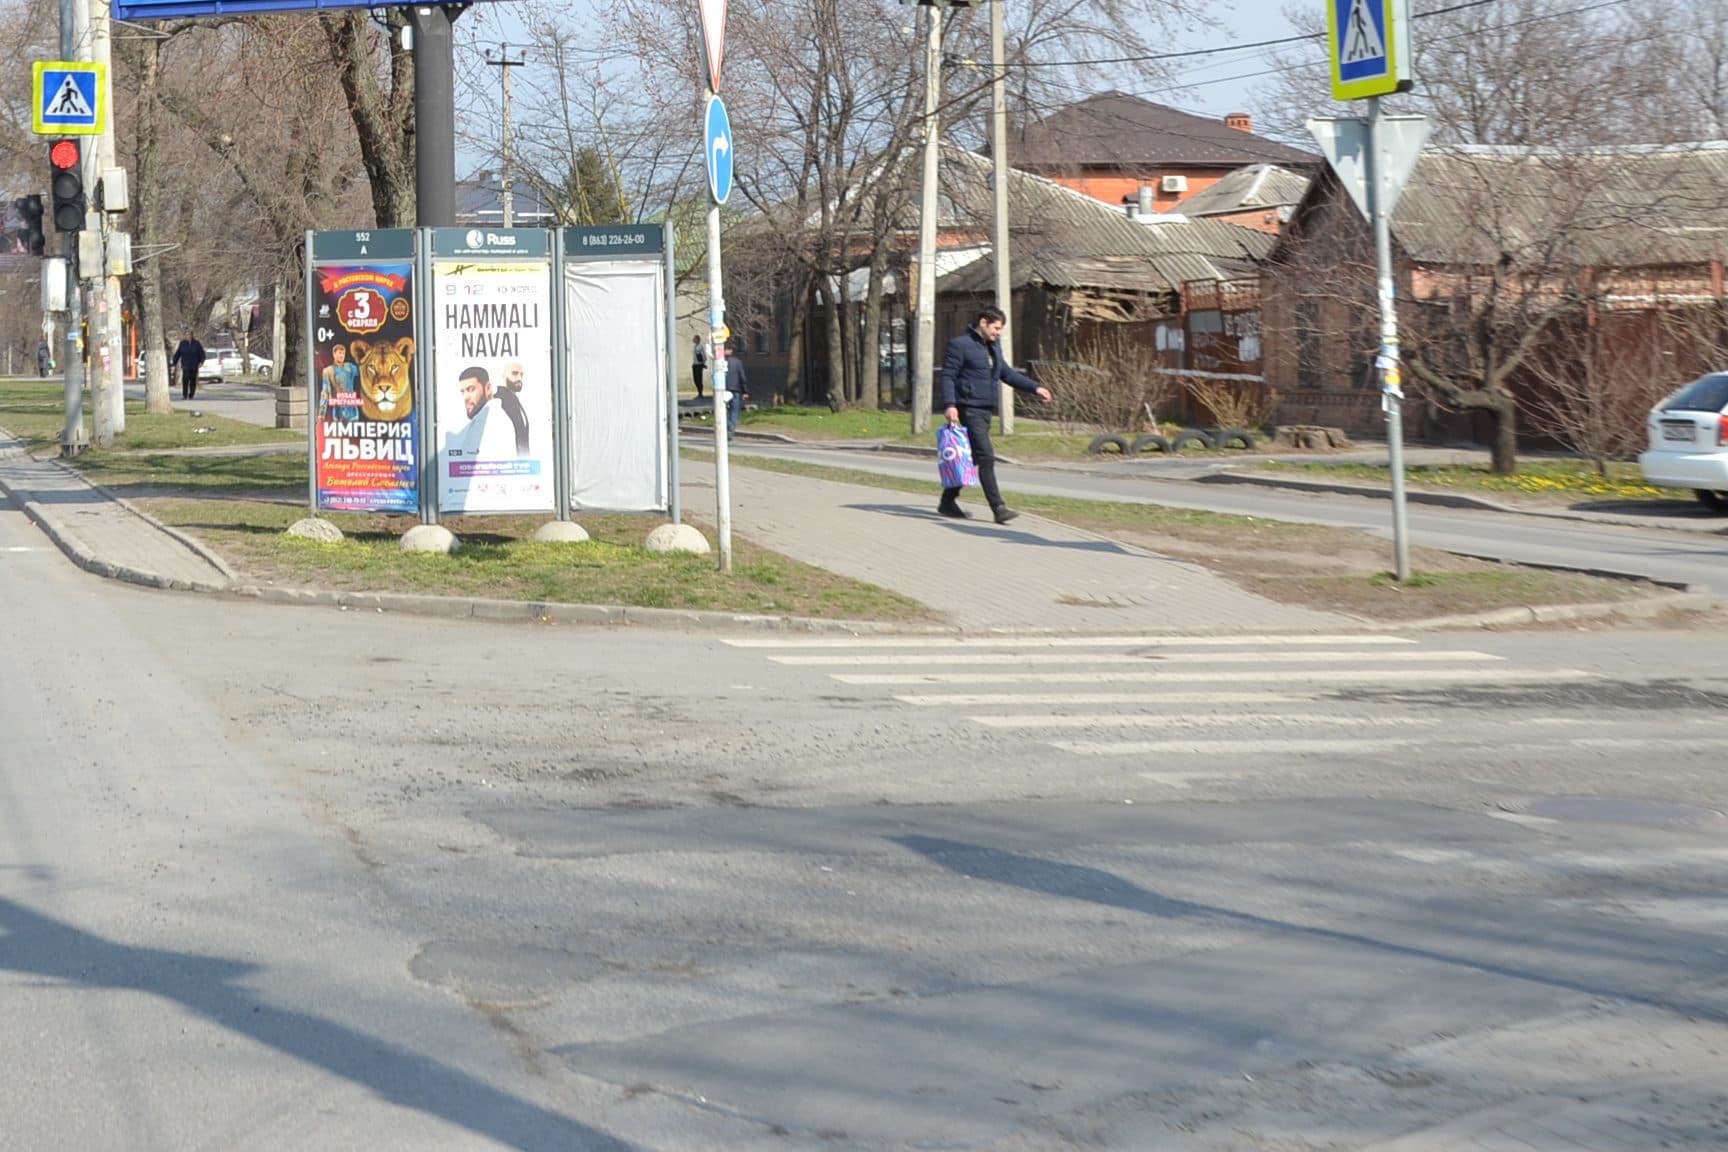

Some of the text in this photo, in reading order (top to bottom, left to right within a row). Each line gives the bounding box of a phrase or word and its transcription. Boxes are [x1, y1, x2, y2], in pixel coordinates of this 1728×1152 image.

[486, 232, 517, 246] Russ
[582, 233, 645, 246] 8 (863) 226-26-00
[354, 292, 370, 319] 3
[347, 318, 378, 328] ФЕВРАЛЯ
[445, 303, 538, 329] HAMMALI
[317, 327, 335, 342] 0+
[461, 332, 519, 358] NAVAI
[323, 421, 412, 438] ИМПЕРИЯ
[321, 438, 414, 465] ЛЬВИЦ
